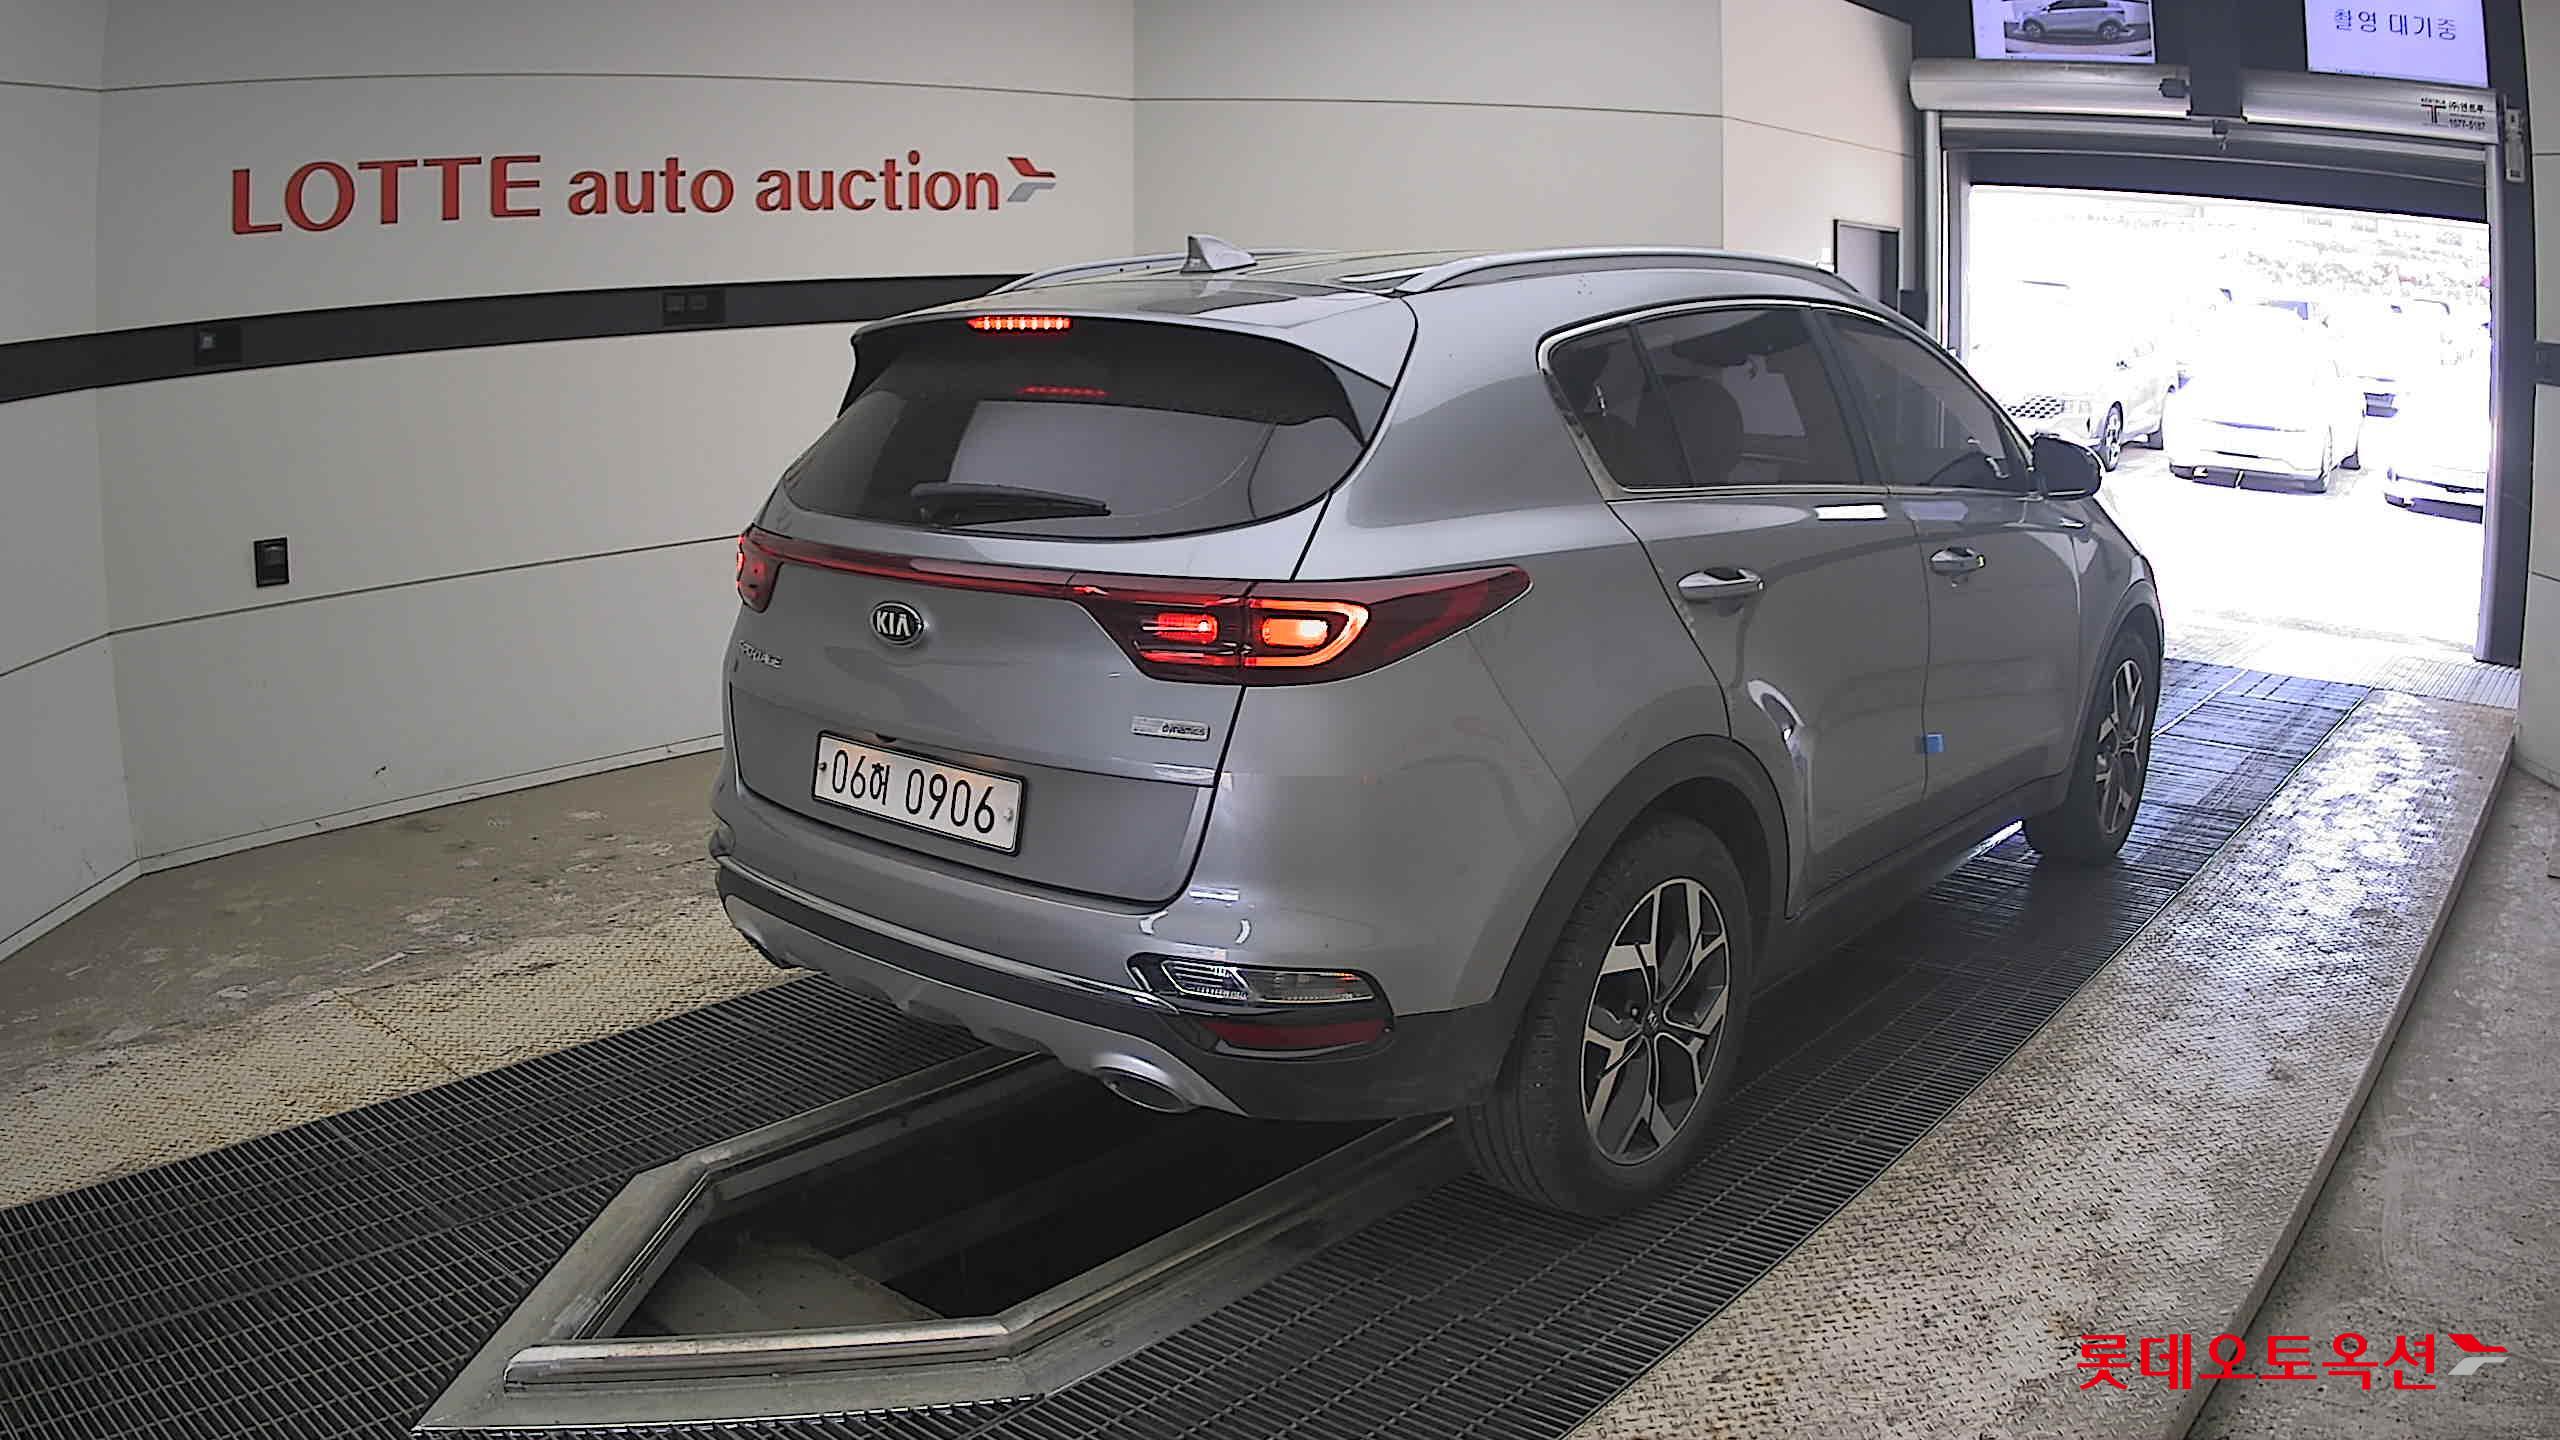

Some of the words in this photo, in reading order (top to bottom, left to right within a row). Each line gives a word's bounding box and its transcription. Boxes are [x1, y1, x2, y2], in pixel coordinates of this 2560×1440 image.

[2334, 8, 2377, 33] 촬영
[2388, 13, 2457, 41] 대기중
[232, 154, 541, 235] LOTTE
[568, 157, 736, 216] auto
[755, 150, 1001, 212] auction
[876, 610, 911, 637] KIA
[832, 749, 890, 806] 06허
[905, 768, 995, 834] 0906
